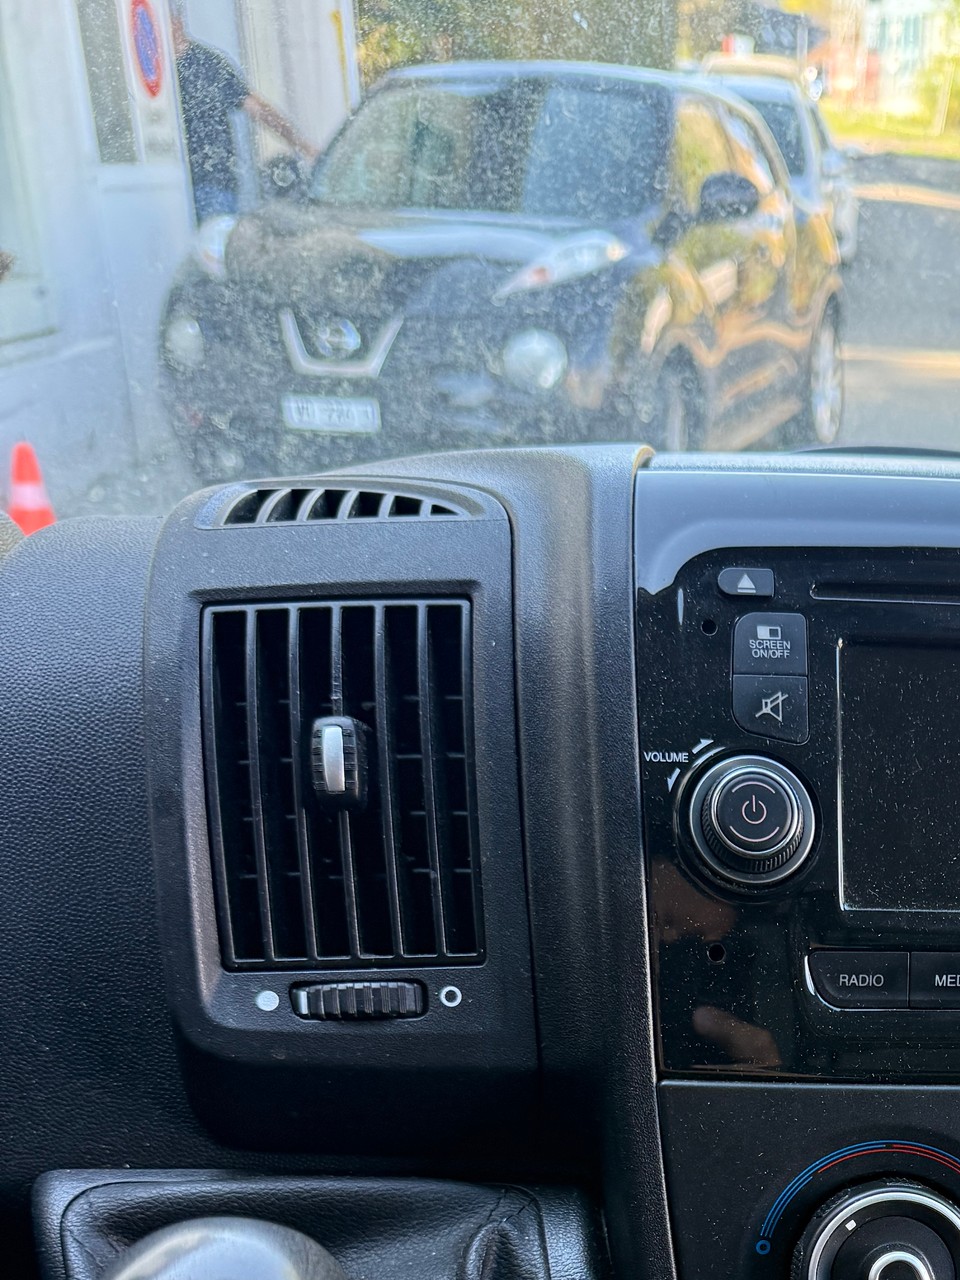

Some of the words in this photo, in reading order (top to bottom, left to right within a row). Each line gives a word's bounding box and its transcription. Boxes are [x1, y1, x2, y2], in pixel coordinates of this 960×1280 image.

[749, 640, 791, 649] SCREEN
[752, 649, 790, 658] ON/OFF
[644, 751, 689, 763] VOLUME
[838, 974, 885, 987] RADIO
